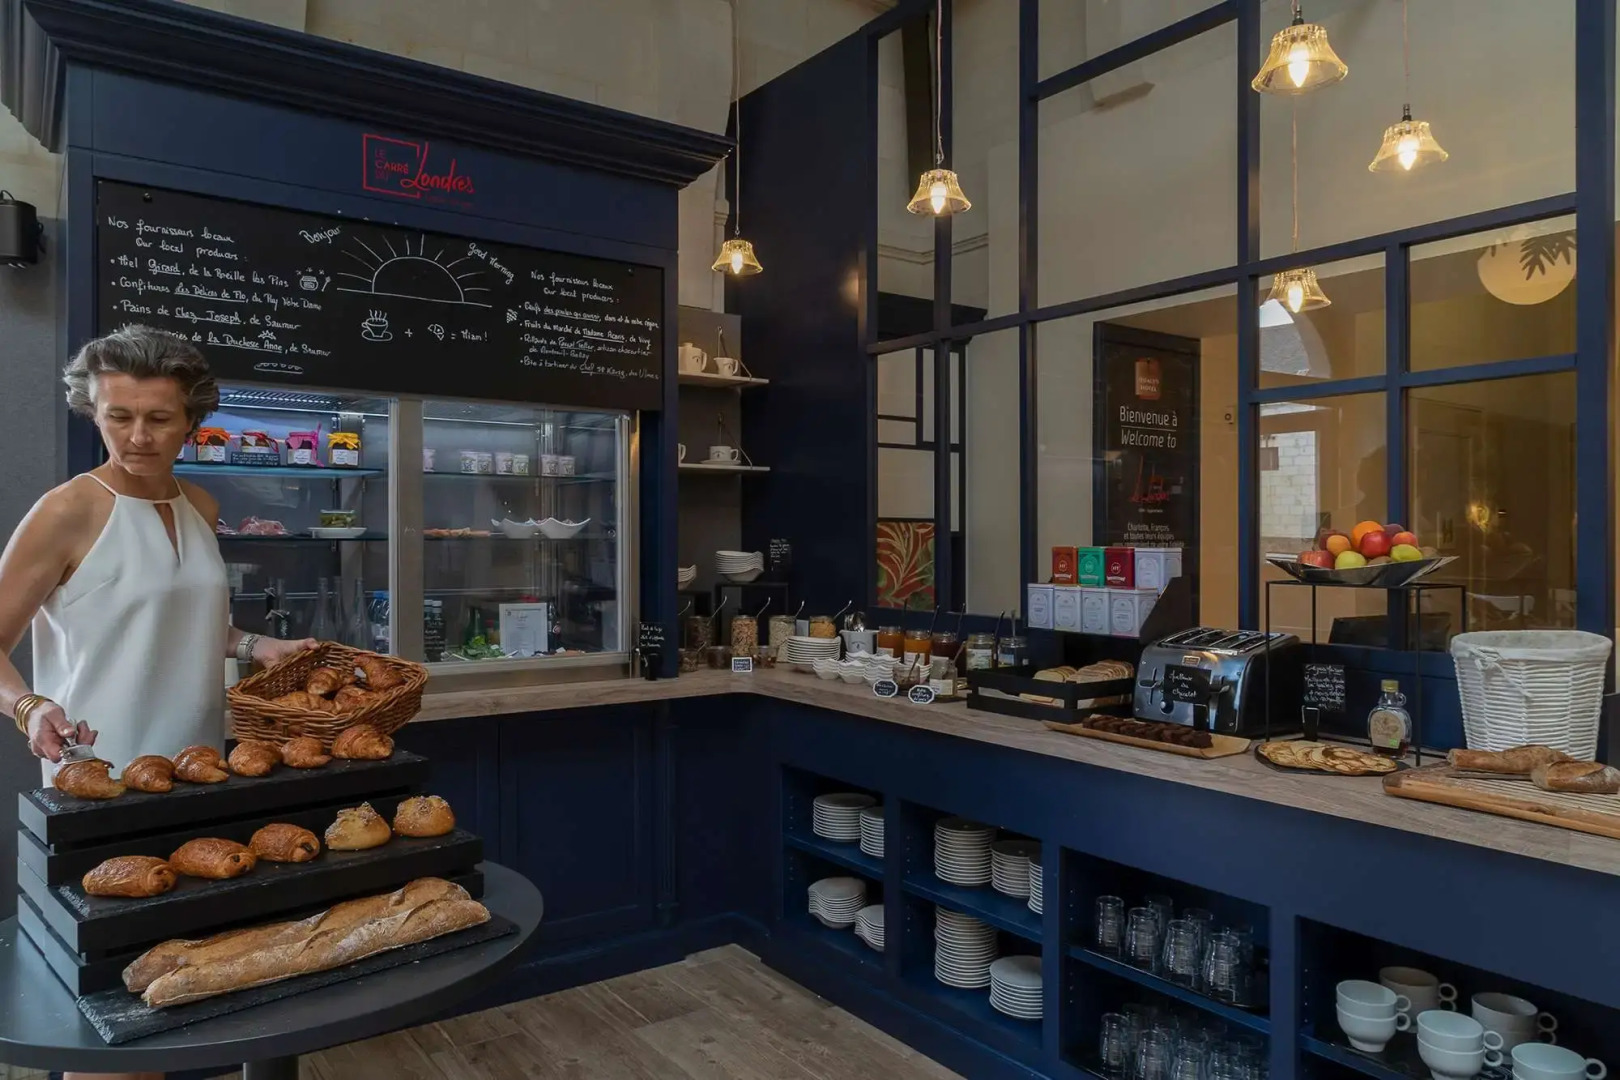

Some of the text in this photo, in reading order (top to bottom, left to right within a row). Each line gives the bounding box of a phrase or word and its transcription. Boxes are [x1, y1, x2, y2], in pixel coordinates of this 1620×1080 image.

[375, 160, 408, 174] CARRÉ
[400, 142, 475, 194] Londres
[108, 216, 234, 243] Nos fournisseurs locaux
[299, 225, 342, 244] Bonjour
[136, 237, 152, 247] Our
[160, 240, 183, 252] local
[189, 264, 199, 275] de
[268, 275, 289, 288] Pins
[530, 270, 544, 280] Nos
[593, 278, 614, 290] locaux
[120, 276, 170, 296] Confitures
[221, 290, 230, 299] de
[120, 300, 151, 314] Pains
[158, 305, 170, 316] de
[175, 307, 197, 323] Chez
[250, 314, 261, 325] de
[265, 315, 302, 329] Saumur
[192, 333, 202, 342] de
[290, 343, 299, 352] de
[1120, 406, 1178, 426] Bienvenue à
[1122, 429, 1176, 448] Welcome to
